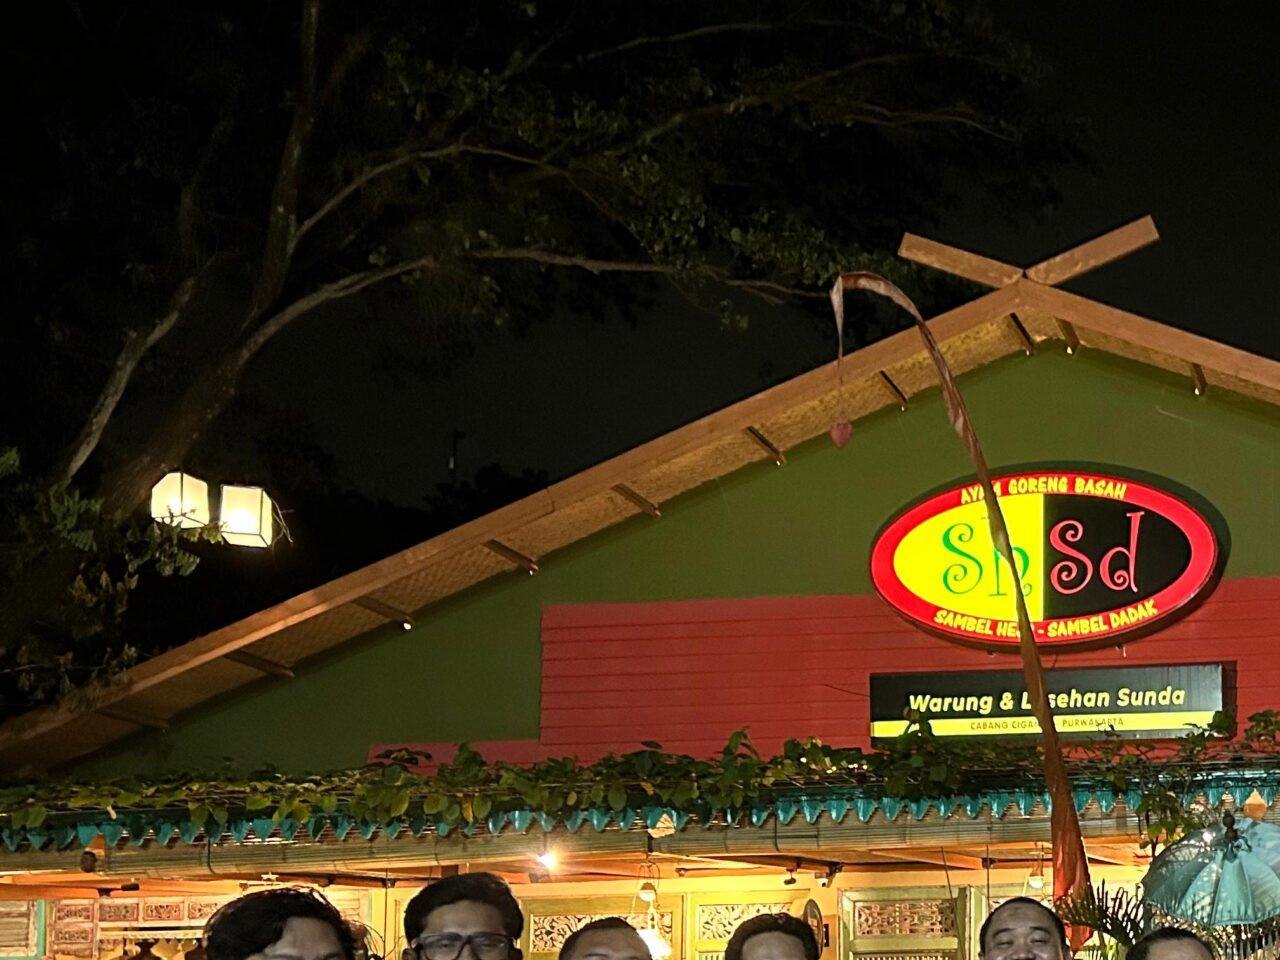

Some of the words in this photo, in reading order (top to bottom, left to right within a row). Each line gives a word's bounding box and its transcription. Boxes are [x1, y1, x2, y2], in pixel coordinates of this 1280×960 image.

[1008, 476, 1068, 495] GORENG
[1075, 478, 1127, 500] BASAH
[934, 610, 993, 636] SAMBEL
[996, 621, 1034, 638] HE
[1047, 616, 1108, 638] SAMBEL
[1110, 599, 1158, 627] DADAK
[909, 694, 994, 715] Warung
[999, 691, 1014, 711] &
[1021, 688, 1110, 711] Lsehan
[1116, 685, 1186, 707] Sunda
[970, 720, 1009, 730] CABANG
